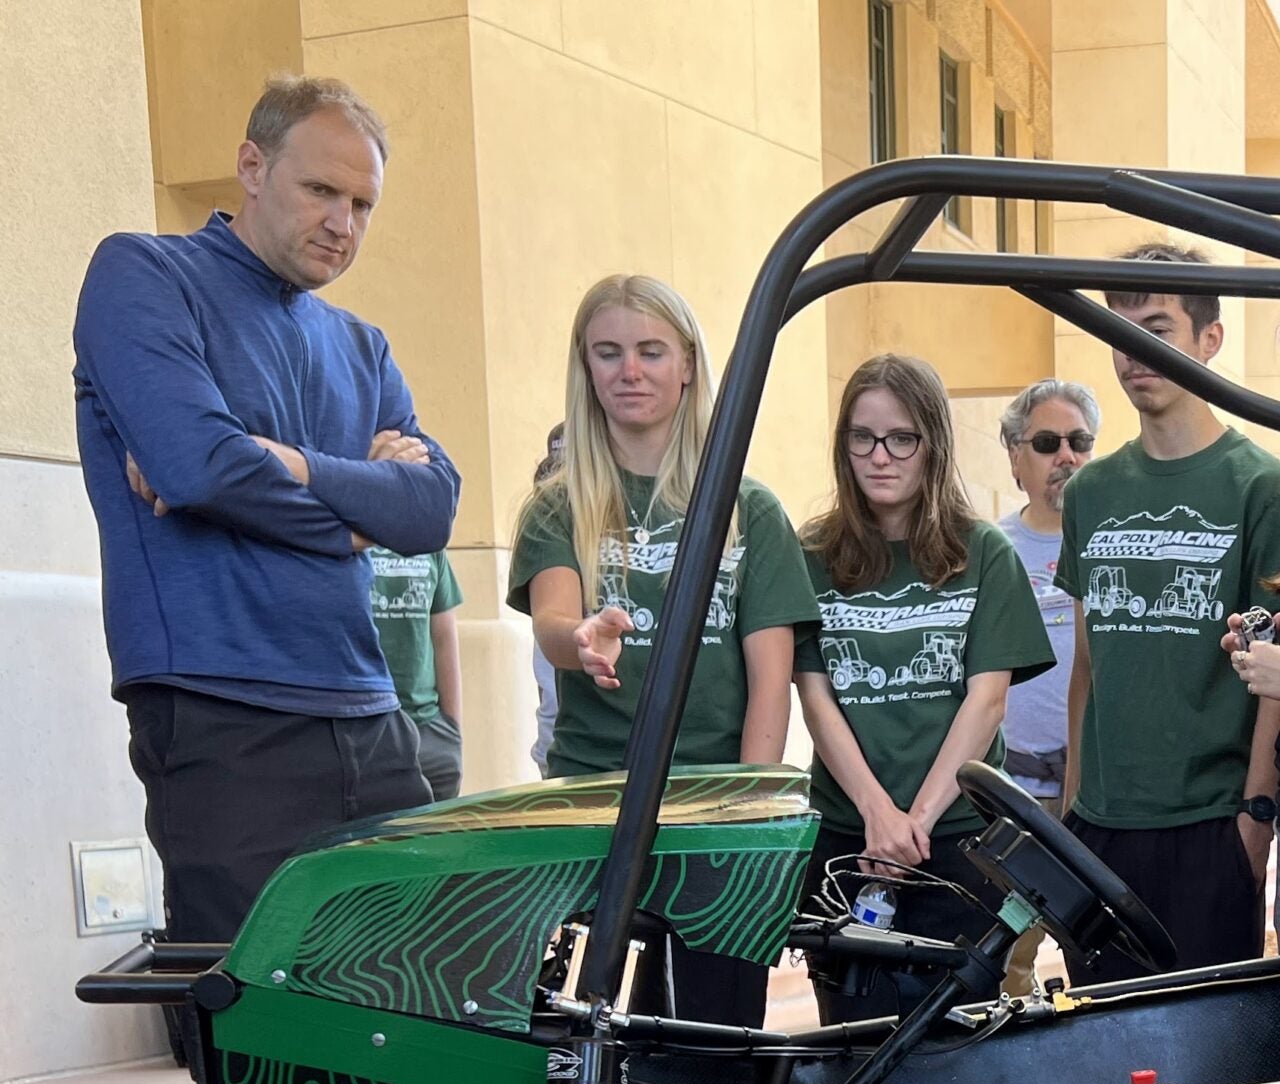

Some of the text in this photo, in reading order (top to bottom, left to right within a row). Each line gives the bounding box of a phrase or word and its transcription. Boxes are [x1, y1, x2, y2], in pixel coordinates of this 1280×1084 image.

[1091, 530, 1237, 548] CAL POLY RACING
[844, 607, 889, 619] POLY
[892, 597, 977, 620] RACING
